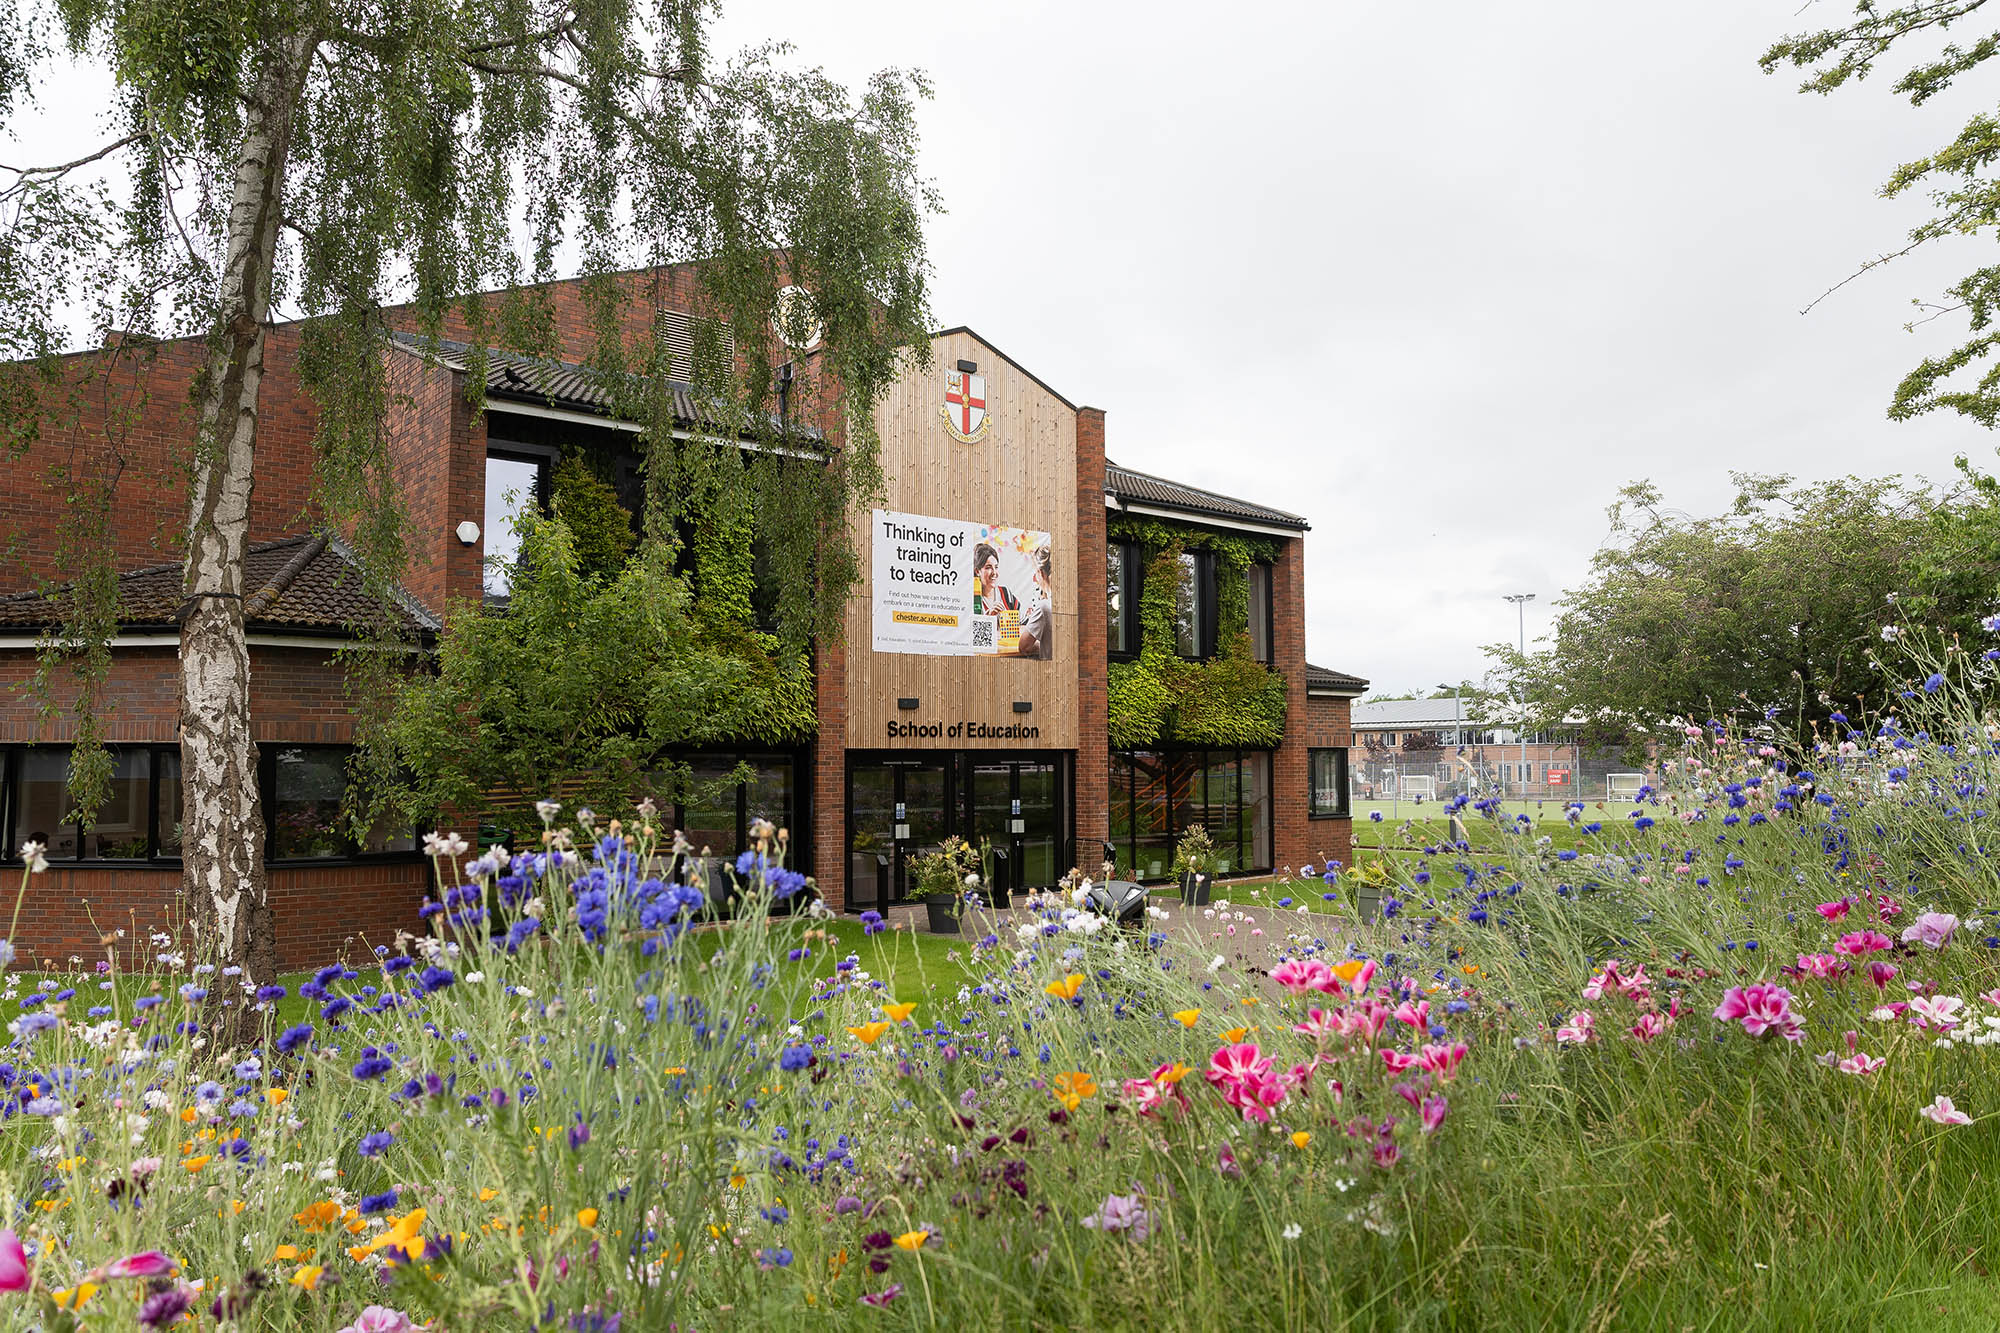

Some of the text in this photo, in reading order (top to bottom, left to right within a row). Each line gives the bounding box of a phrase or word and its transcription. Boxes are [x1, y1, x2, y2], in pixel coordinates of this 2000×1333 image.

[883, 522, 964, 549] Thinking of
[897, 546, 951, 570] training
[890, 566, 958, 586] to teach?
[883, 598, 902, 606] embark
[896, 613, 956, 625] chester.ac.uk/teach
[887, 721, 1040, 739] School of Education
